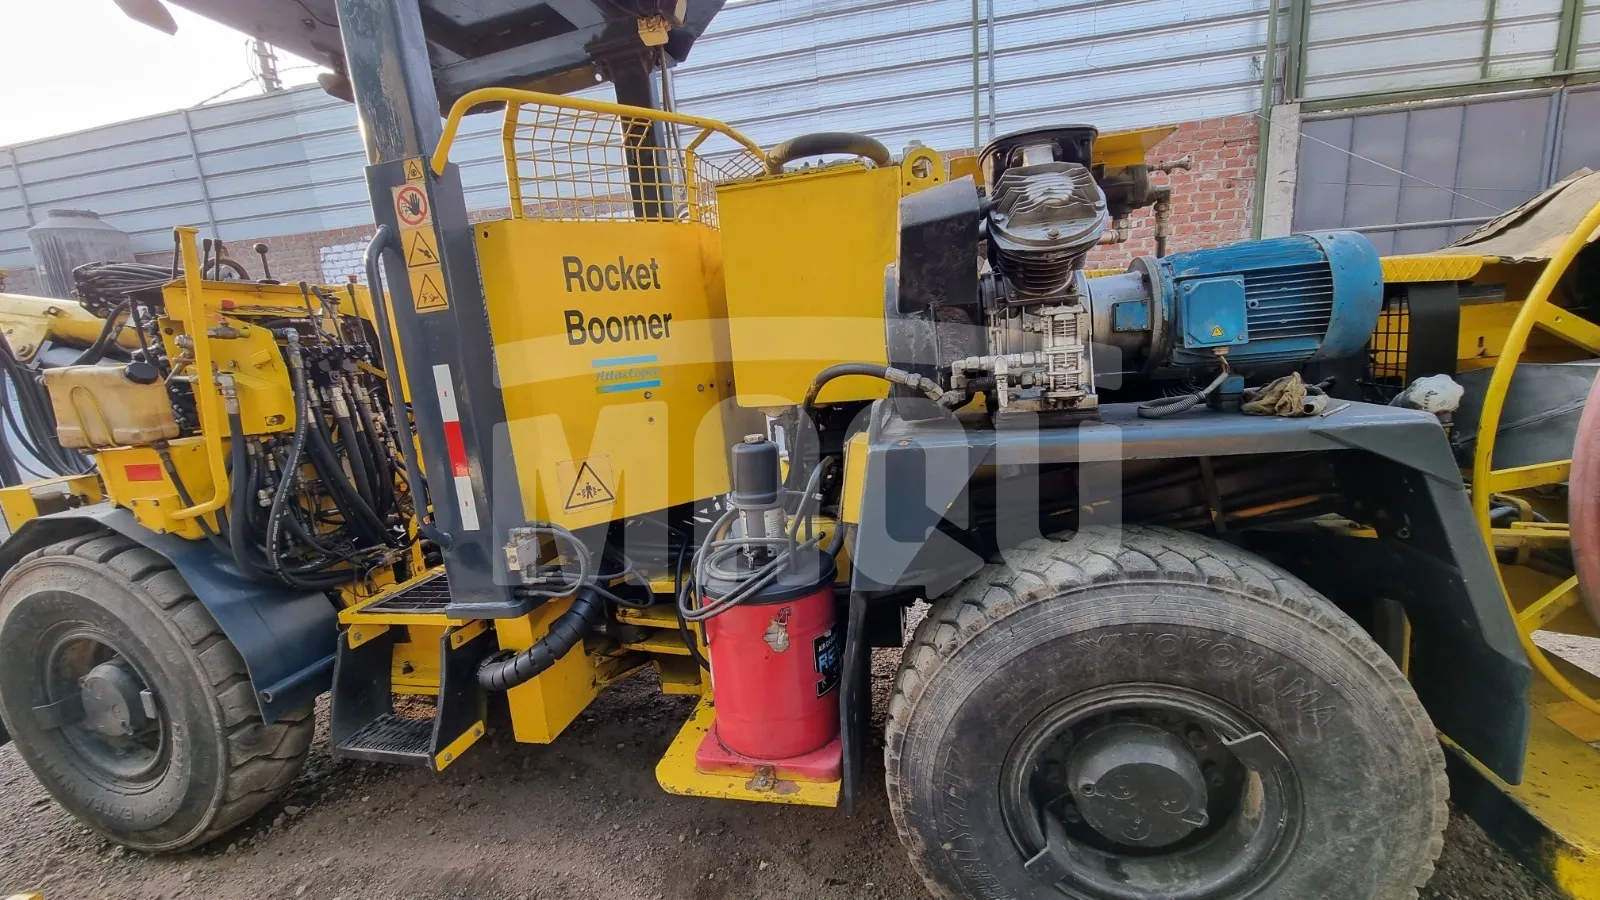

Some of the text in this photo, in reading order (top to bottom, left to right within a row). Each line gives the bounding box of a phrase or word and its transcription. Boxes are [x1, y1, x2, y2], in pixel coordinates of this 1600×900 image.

[562, 256, 661, 292] Rocket
[564, 309, 672, 345] Boomer
[818, 646, 836, 673] RE
[1126, 632, 1337, 729] YOKOHAMA
